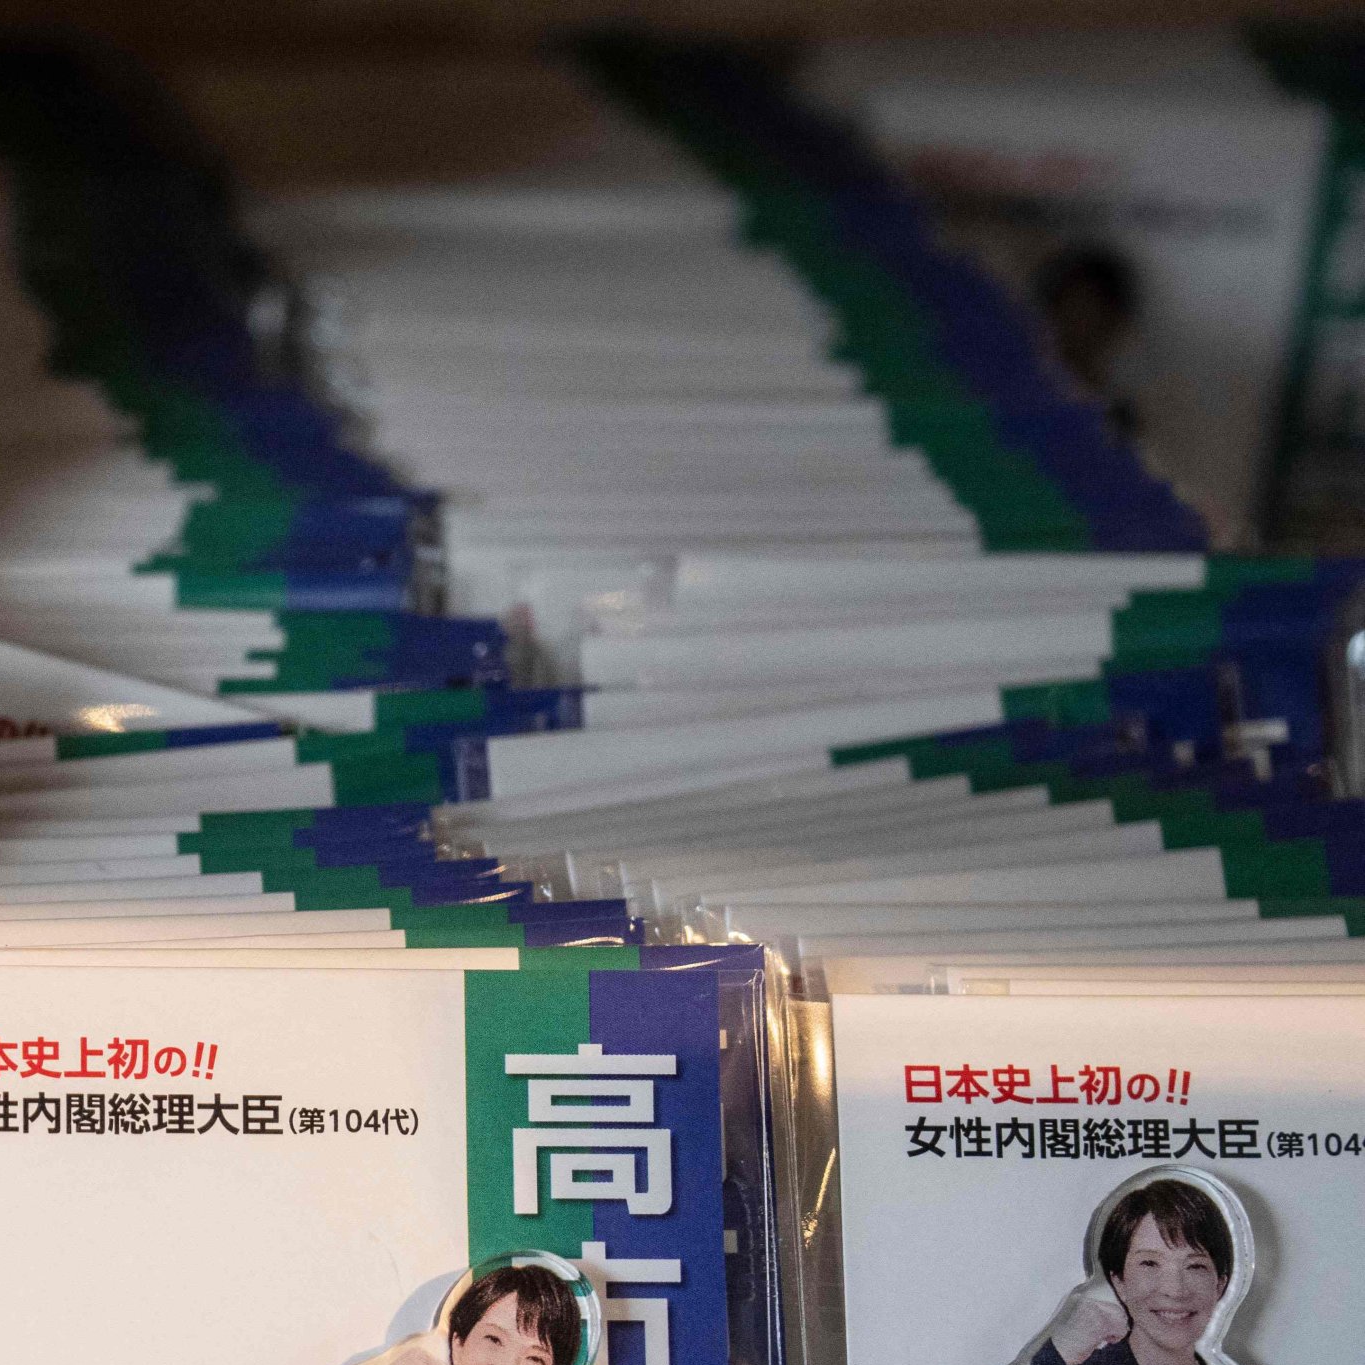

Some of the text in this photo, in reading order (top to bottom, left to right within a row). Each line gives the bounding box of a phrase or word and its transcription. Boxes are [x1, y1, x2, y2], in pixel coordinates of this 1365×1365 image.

[904, 1064, 1192, 1107] 日本史上初の!!
[905, 1116, 1365, 1160] 女性内閣総理大臣(第104
